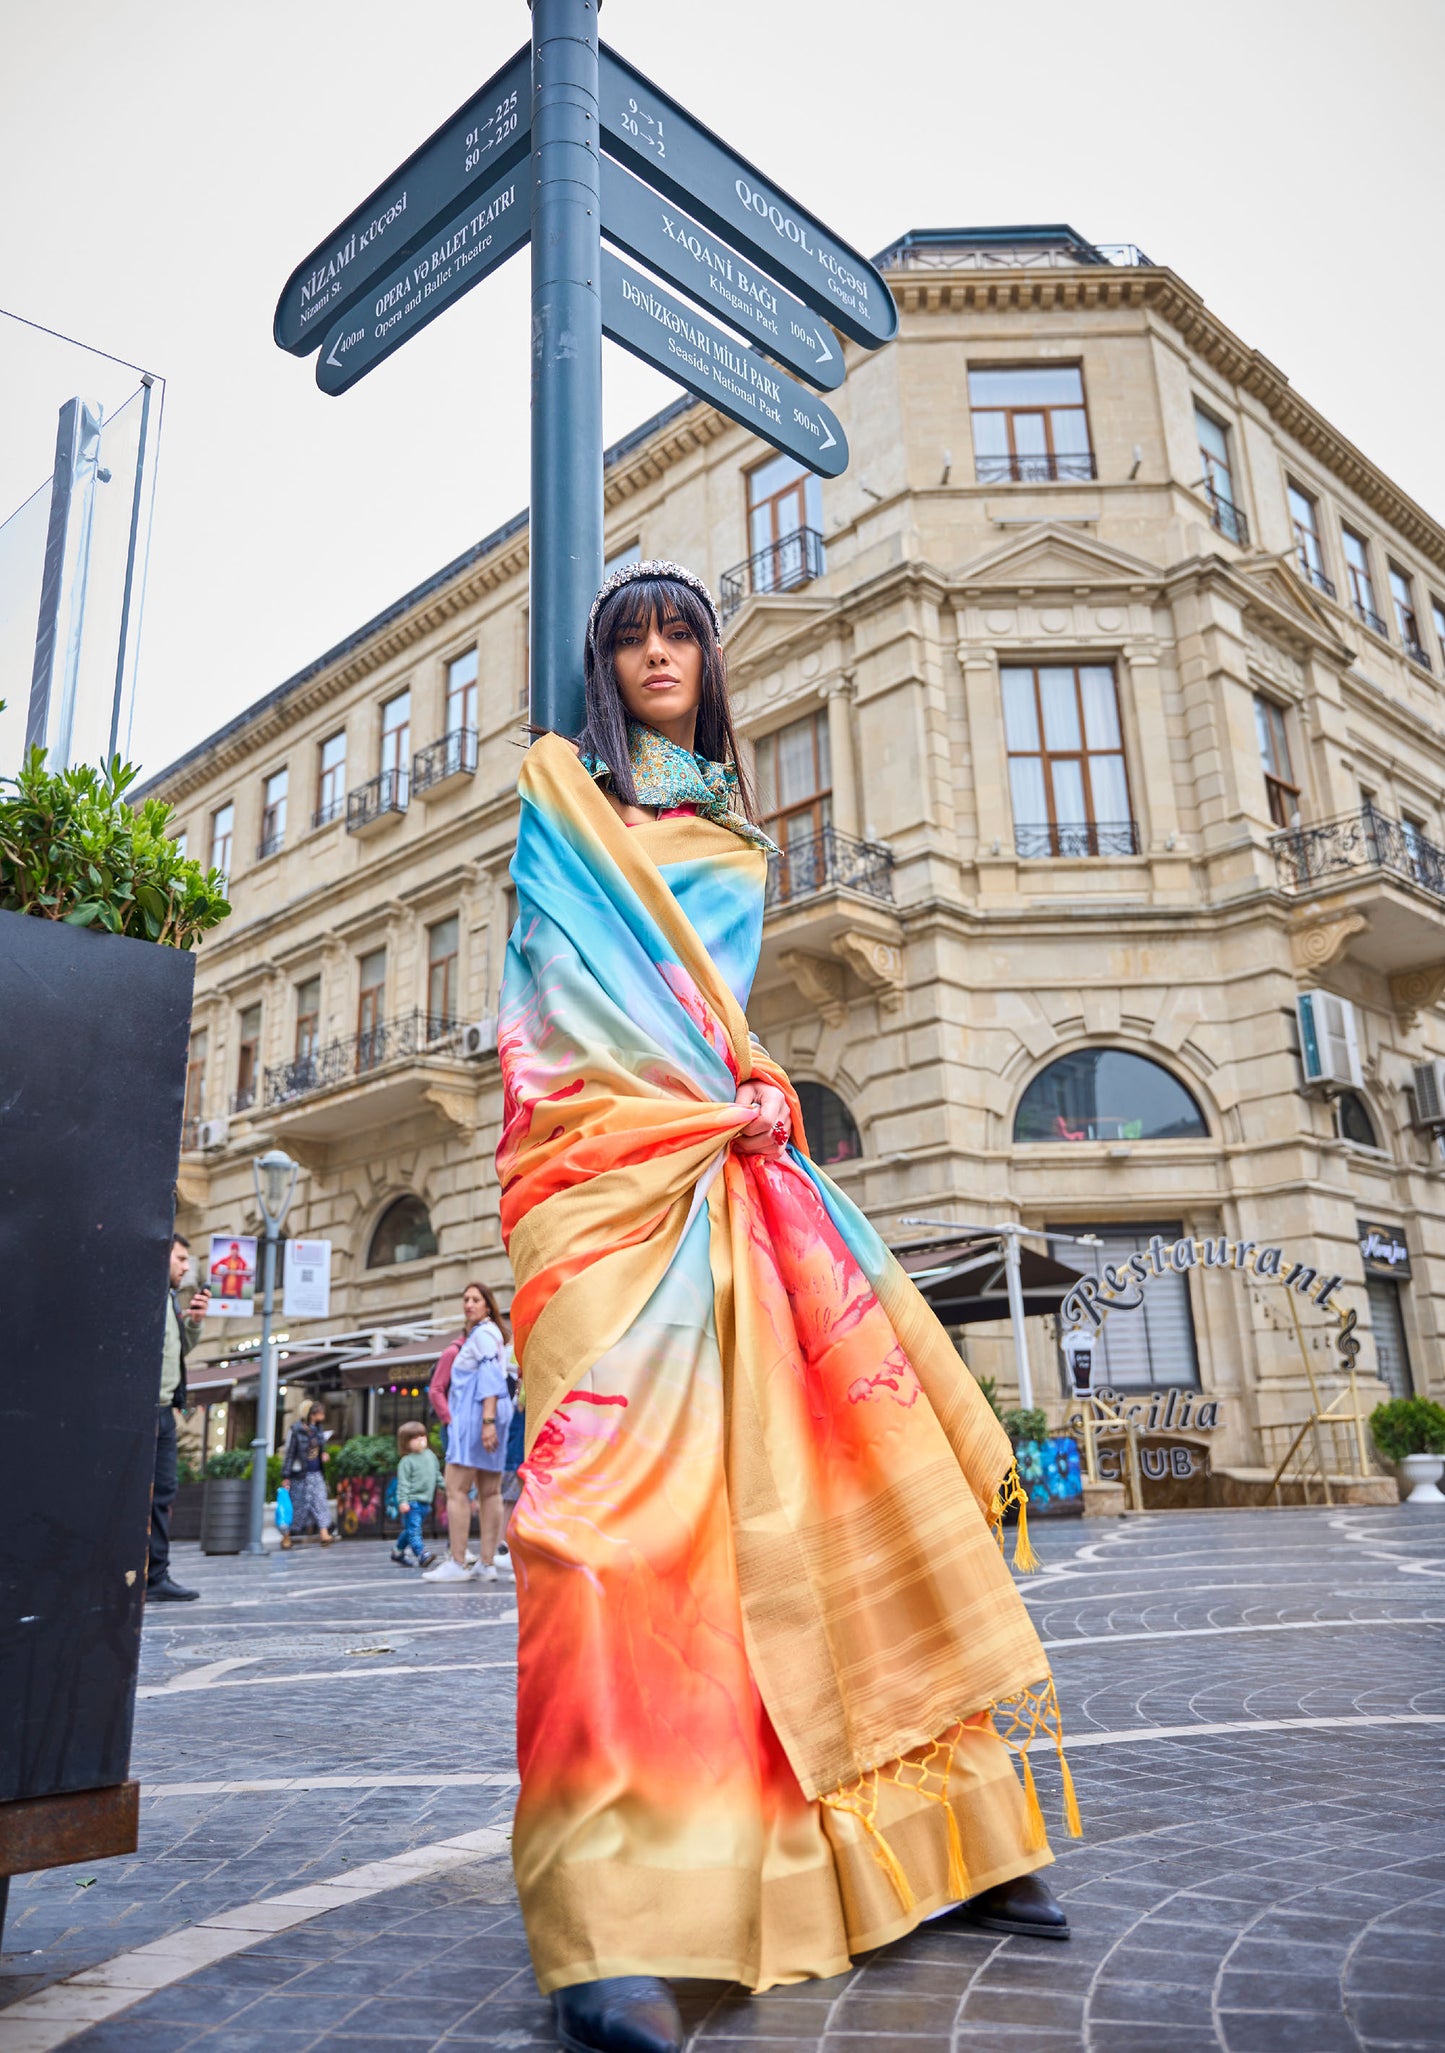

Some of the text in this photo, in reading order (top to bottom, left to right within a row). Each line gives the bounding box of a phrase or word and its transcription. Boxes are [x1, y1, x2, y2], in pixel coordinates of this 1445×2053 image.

[465, 113, 518, 172] 80 220
[466, 91, 518, 151] 91 225
[621, 113, 666, 158] 20 2
[629, 98, 664, 137] 9 1
[736, 179, 813, 256] QOQOL
[301, 234, 356, 307] NİZAMİ
[376, 184, 516, 317] OPERA VƏ BALET TEATRI
[662, 214, 778, 316] XAQANİ BAĞI
[300, 281, 342, 326] Nizami St.
[375, 234, 492, 338] Opera and Ballet Theatre
[709, 274, 778, 336] Khagani Park
[828, 278, 870, 320] Gogol St.
[341, 328, 364, 353] 400m
[622, 278, 782, 404] DƏNİZKƏNARI MİLLİ PARK
[668, 338, 782, 425] Seaside National Park
[1061, 1234, 1344, 1329] Restaurant
[1070, 1386, 1219, 1438] Sicilia
